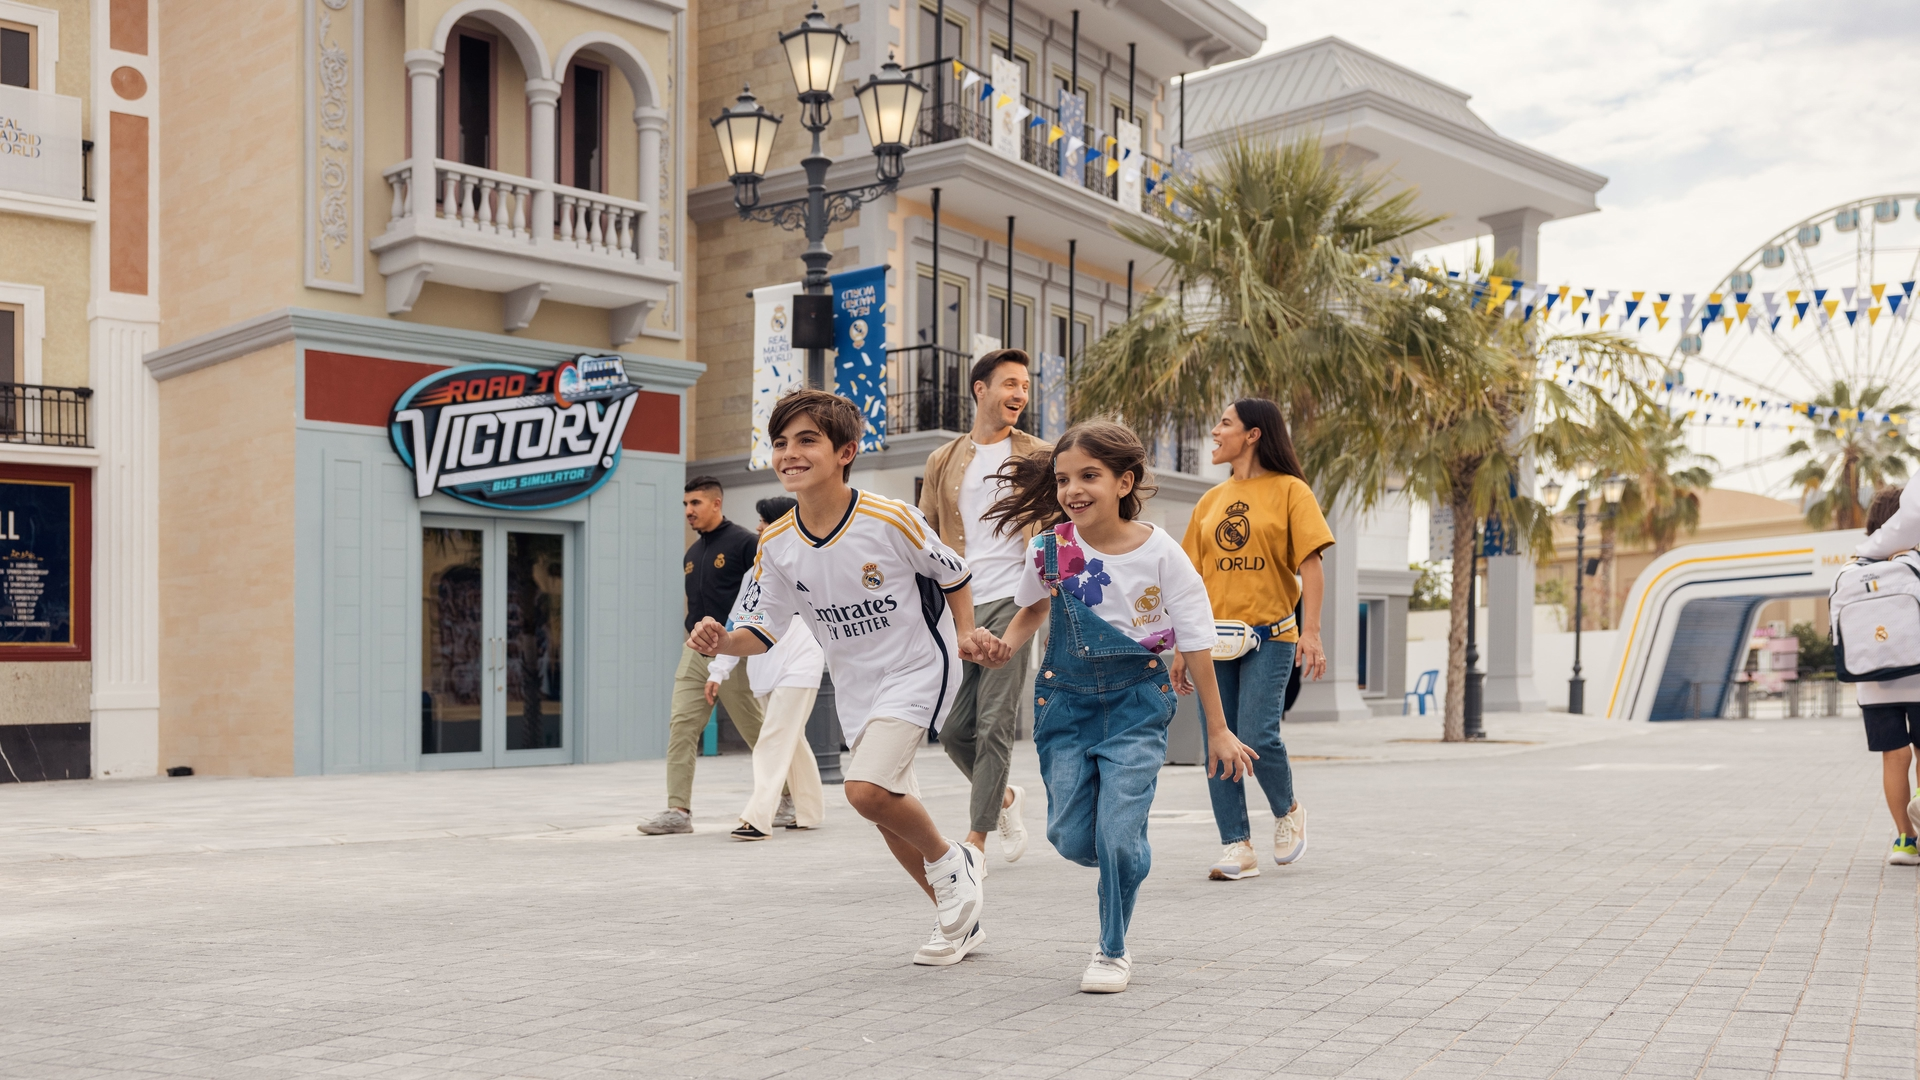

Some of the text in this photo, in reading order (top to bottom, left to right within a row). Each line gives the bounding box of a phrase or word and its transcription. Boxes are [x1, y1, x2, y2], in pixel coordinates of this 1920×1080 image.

[768, 335, 788, 345] REAL
[763, 352, 793, 364] WORLD
[448, 374, 526, 403] ROAD
[395, 392, 640, 498] VICTORY!
[492, 468, 585, 492] BUS SIMULATOR
[808, 594, 897, 624] mirates
[843, 616, 891, 638] BETTER
